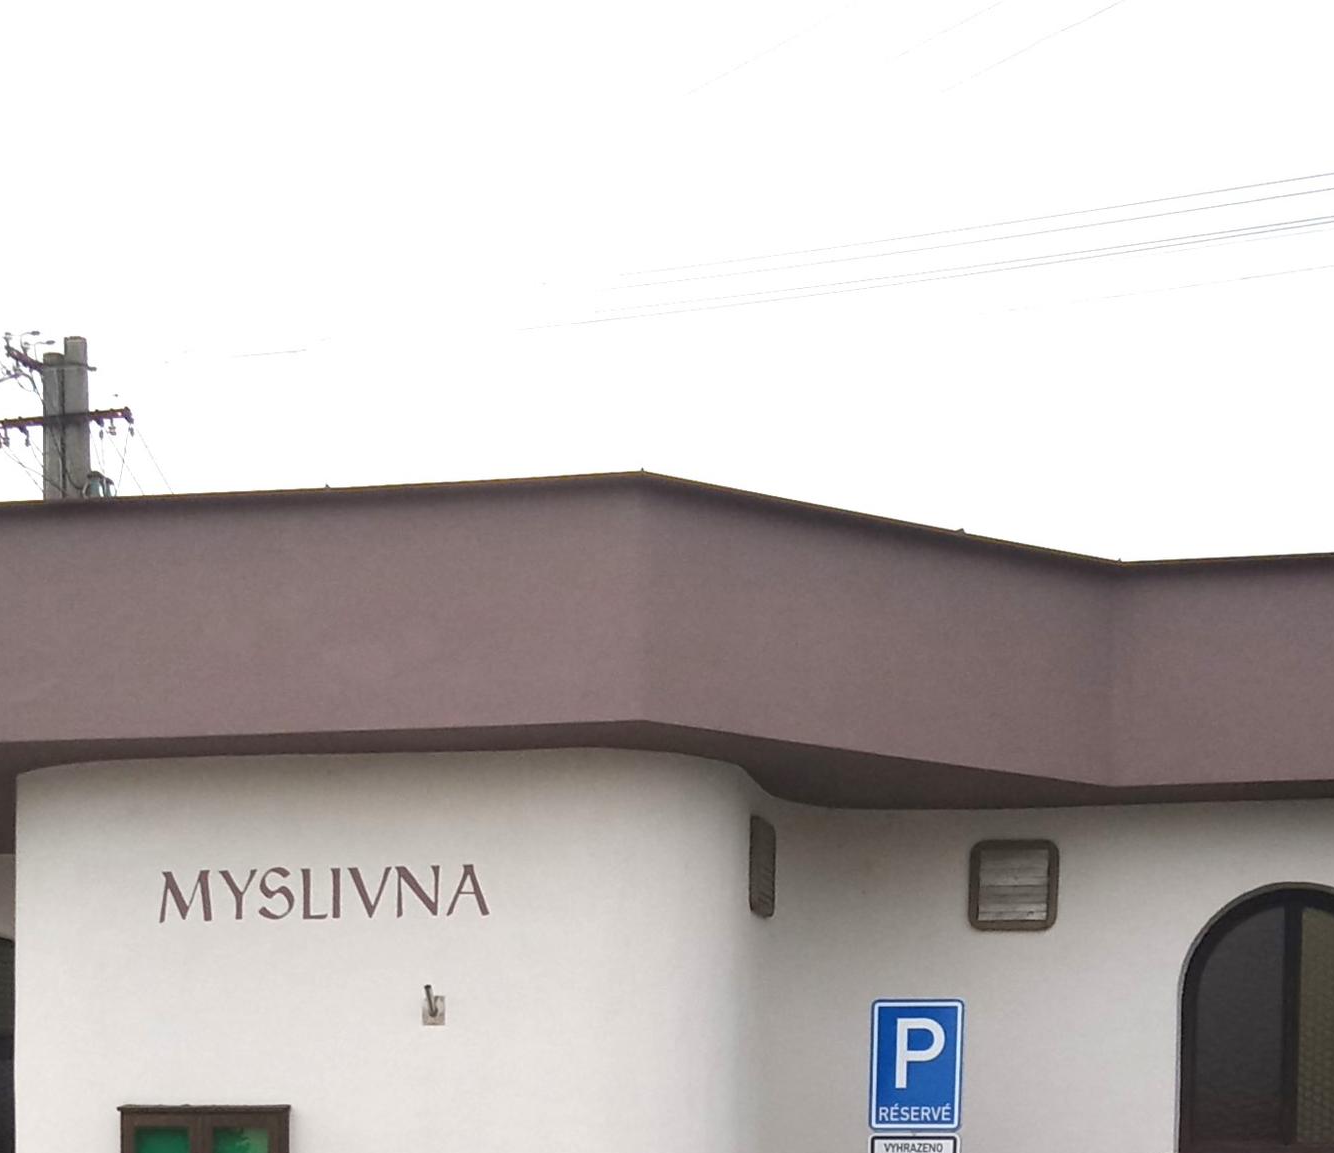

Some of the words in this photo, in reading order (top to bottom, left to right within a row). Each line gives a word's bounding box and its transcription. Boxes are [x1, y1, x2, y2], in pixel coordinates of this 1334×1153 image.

[158, 863, 491, 924] MYSLIVNA
[895, 1017, 946, 1089] P
[878, 1103, 952, 1121] RÉSERVÉ
[883, 1143, 944, 1153] VYHRAZENO
